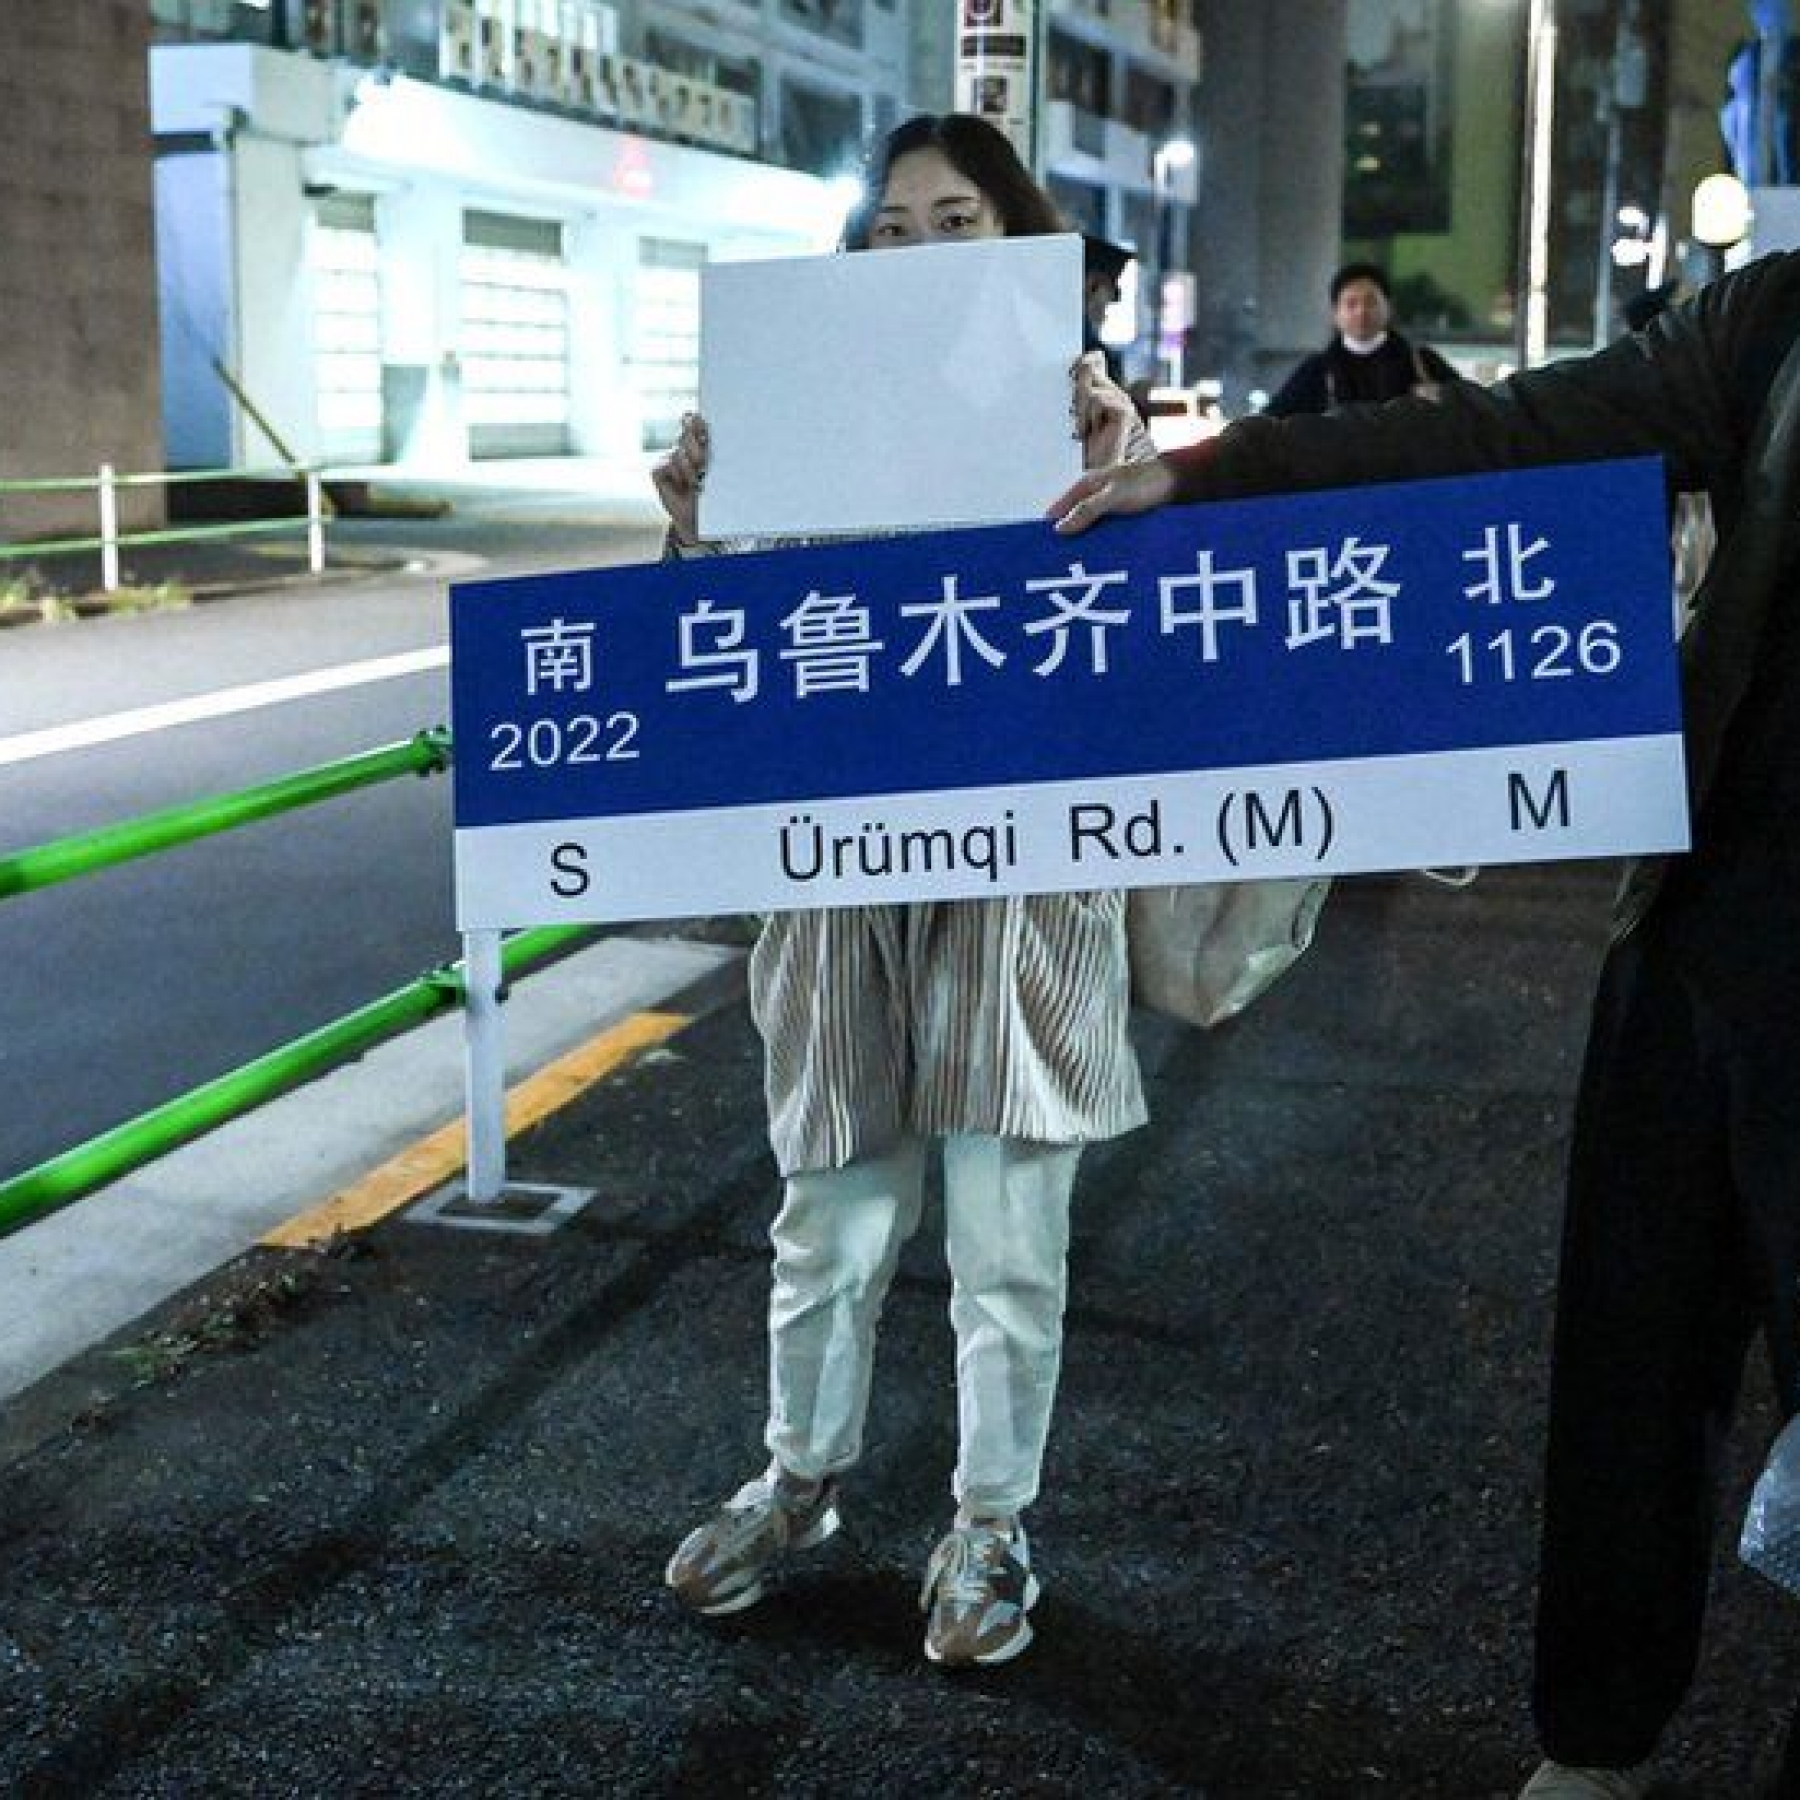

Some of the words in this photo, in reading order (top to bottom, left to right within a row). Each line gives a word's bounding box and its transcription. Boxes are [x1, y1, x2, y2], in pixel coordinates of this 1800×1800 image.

[1462, 523, 1556, 604] 北
[665, 537, 1401, 703] 乌鲁木齐中路
[1447, 620, 1621, 685] 1126
[520, 618, 597, 695] 南
[489, 711, 640, 771] 2022
[779, 809, 1016, 883] Ürümqi
[1069, 800, 1185, 863] Rd.
[1218, 786, 1334, 866] (M)
[1507, 769, 1571, 830] M
[549, 842, 591, 898] S
